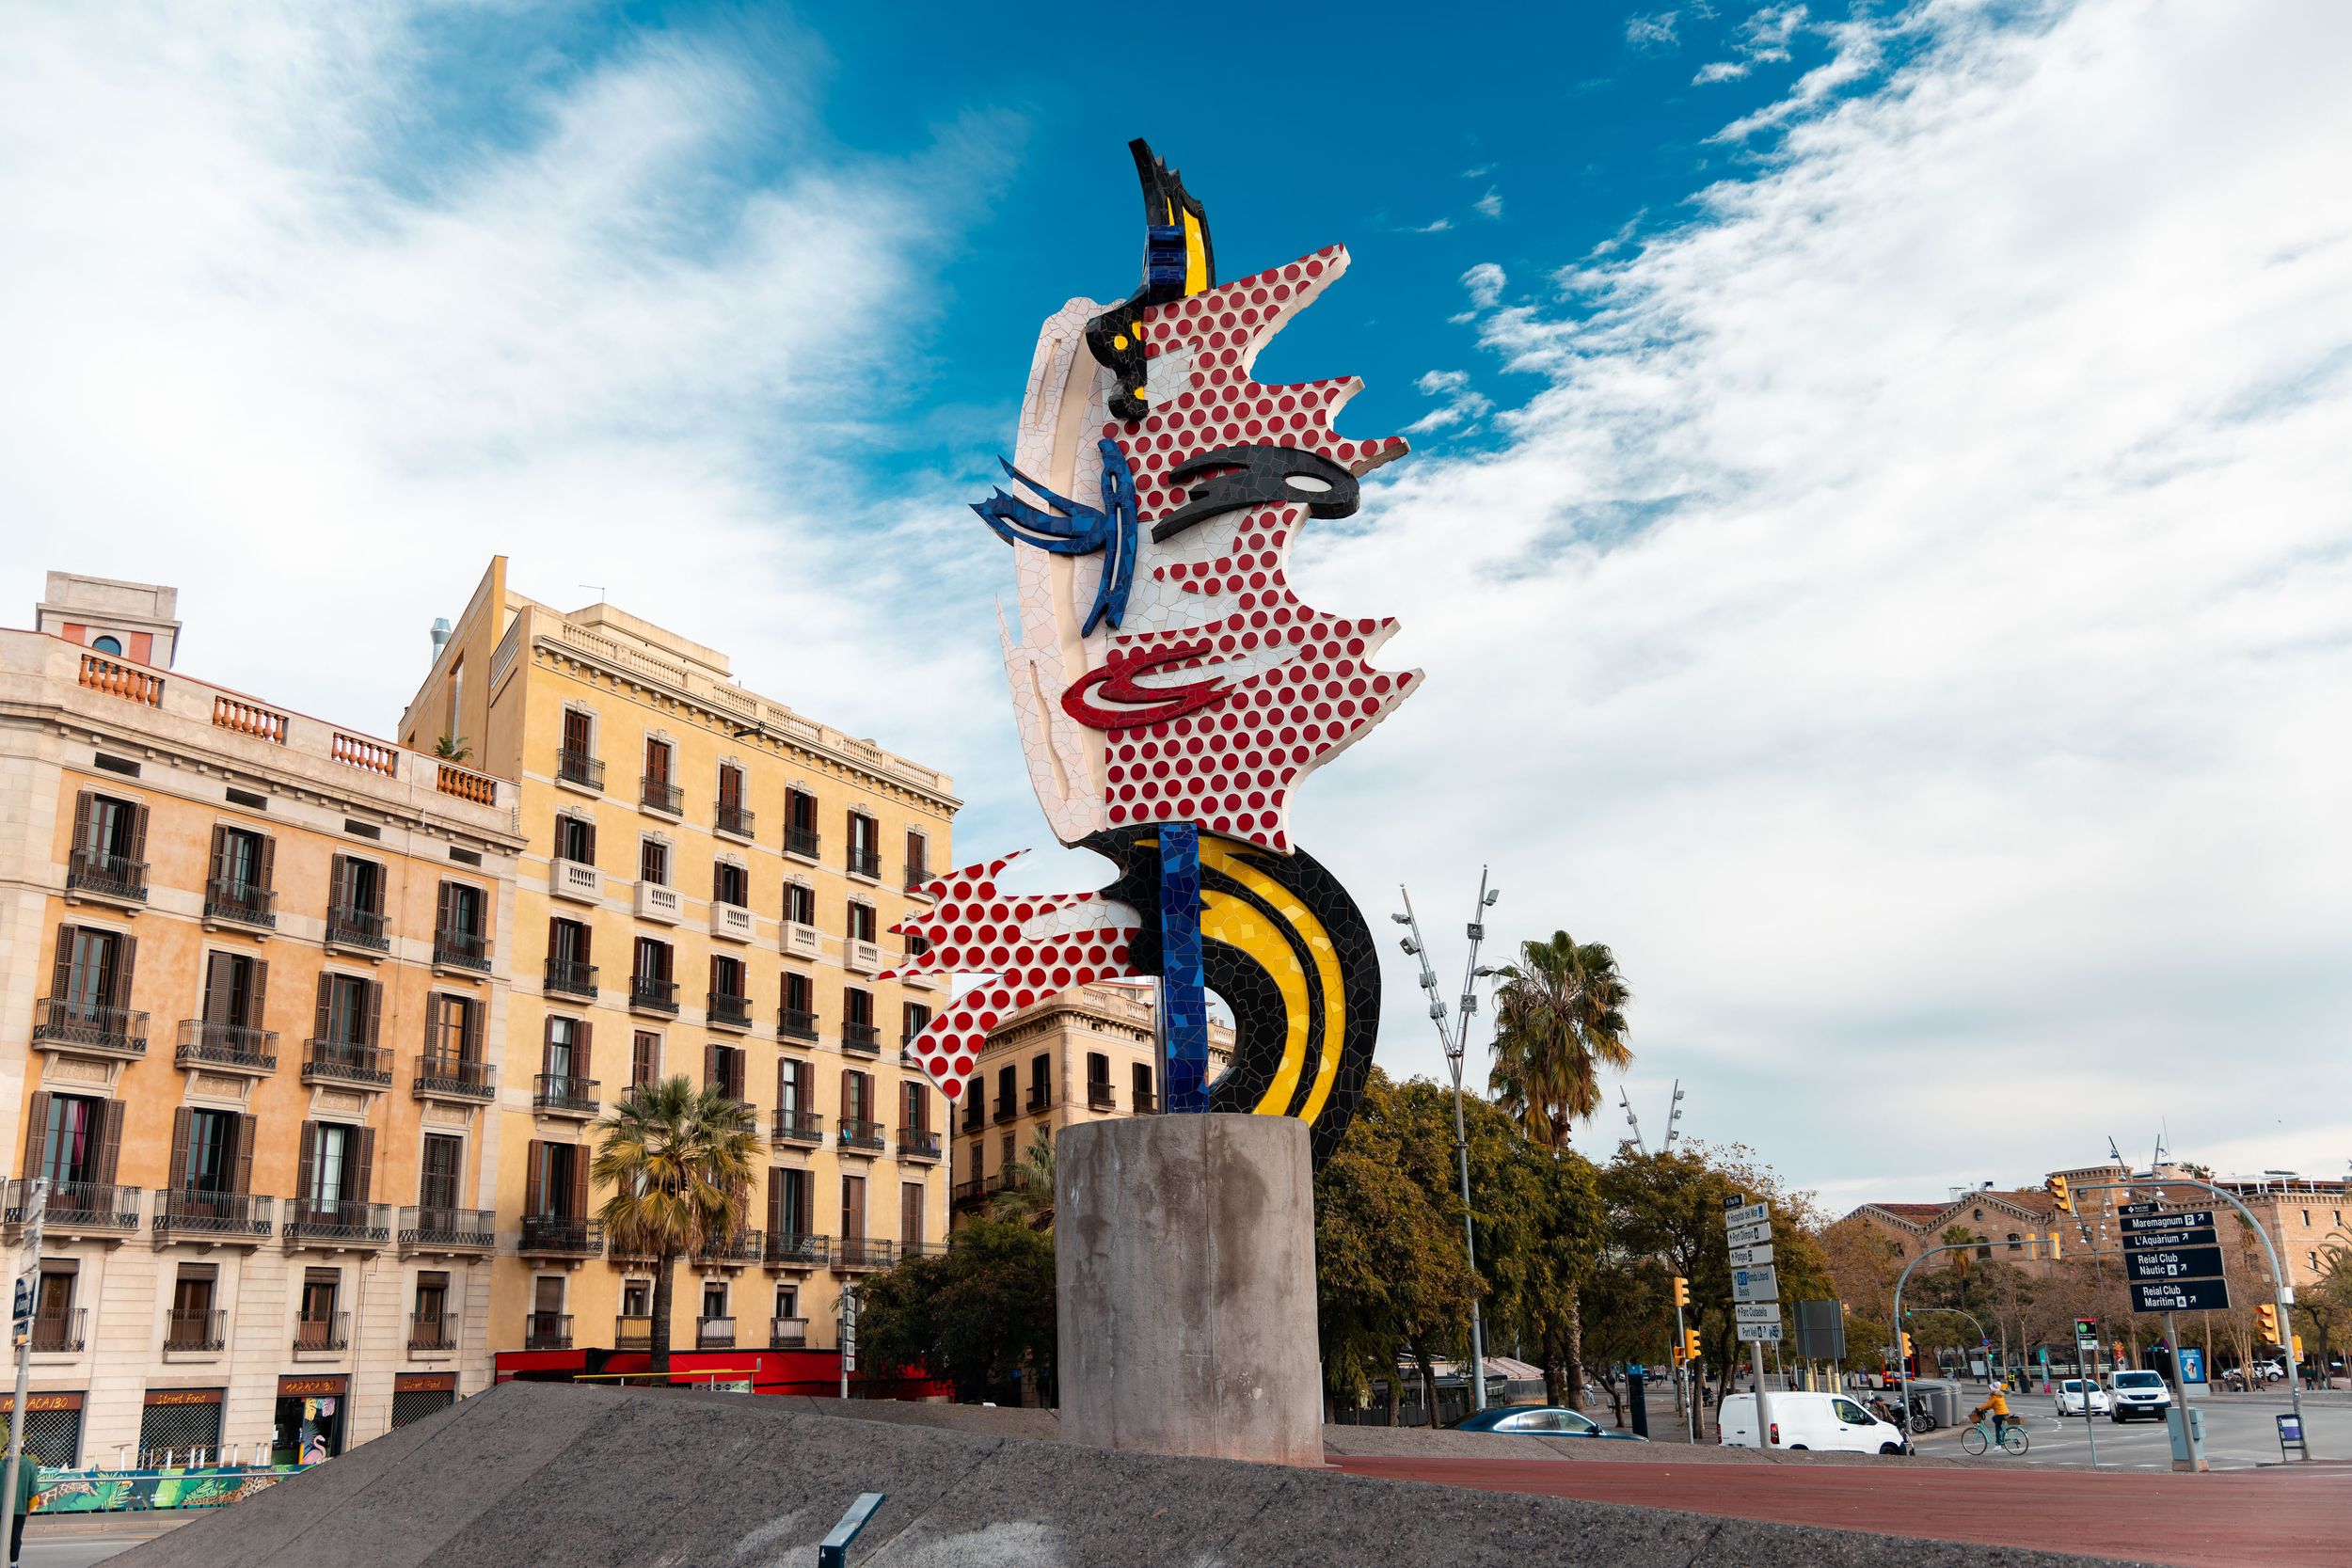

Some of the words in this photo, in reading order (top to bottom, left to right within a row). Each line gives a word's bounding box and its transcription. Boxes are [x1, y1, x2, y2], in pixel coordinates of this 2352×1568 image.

[1730, 1210, 1744, 1223] Hospital
[2132, 1215, 2183, 1228] Maremagnum
[1732, 1232, 1740, 1242] Port
[2135, 1234, 2179, 1246] L'Aquàrium
[1734, 1251, 1747, 1263] Platges
[2137, 1254, 2157, 1264] Reial
[2159, 1253, 2178, 1263] Club
[2139, 1265, 2166, 1275] Nàutic
[1747, 1272, 1757, 1282] Ronda
[1758, 1270, 1769, 1281] Litoral
[2142, 1286, 2162, 1296] Reial
[2163, 1285, 2181, 1295] Club
[2144, 1296, 2175, 1307] Marítim
[1740, 1307, 1749, 1317] Parc
[1749, 1307, 1767, 1317] Ciutadella
[3, 1397, 69, 1410] MACAIBO
[156, 1393, 183, 1404] Street
[185, 1393, 207, 1403] Food
